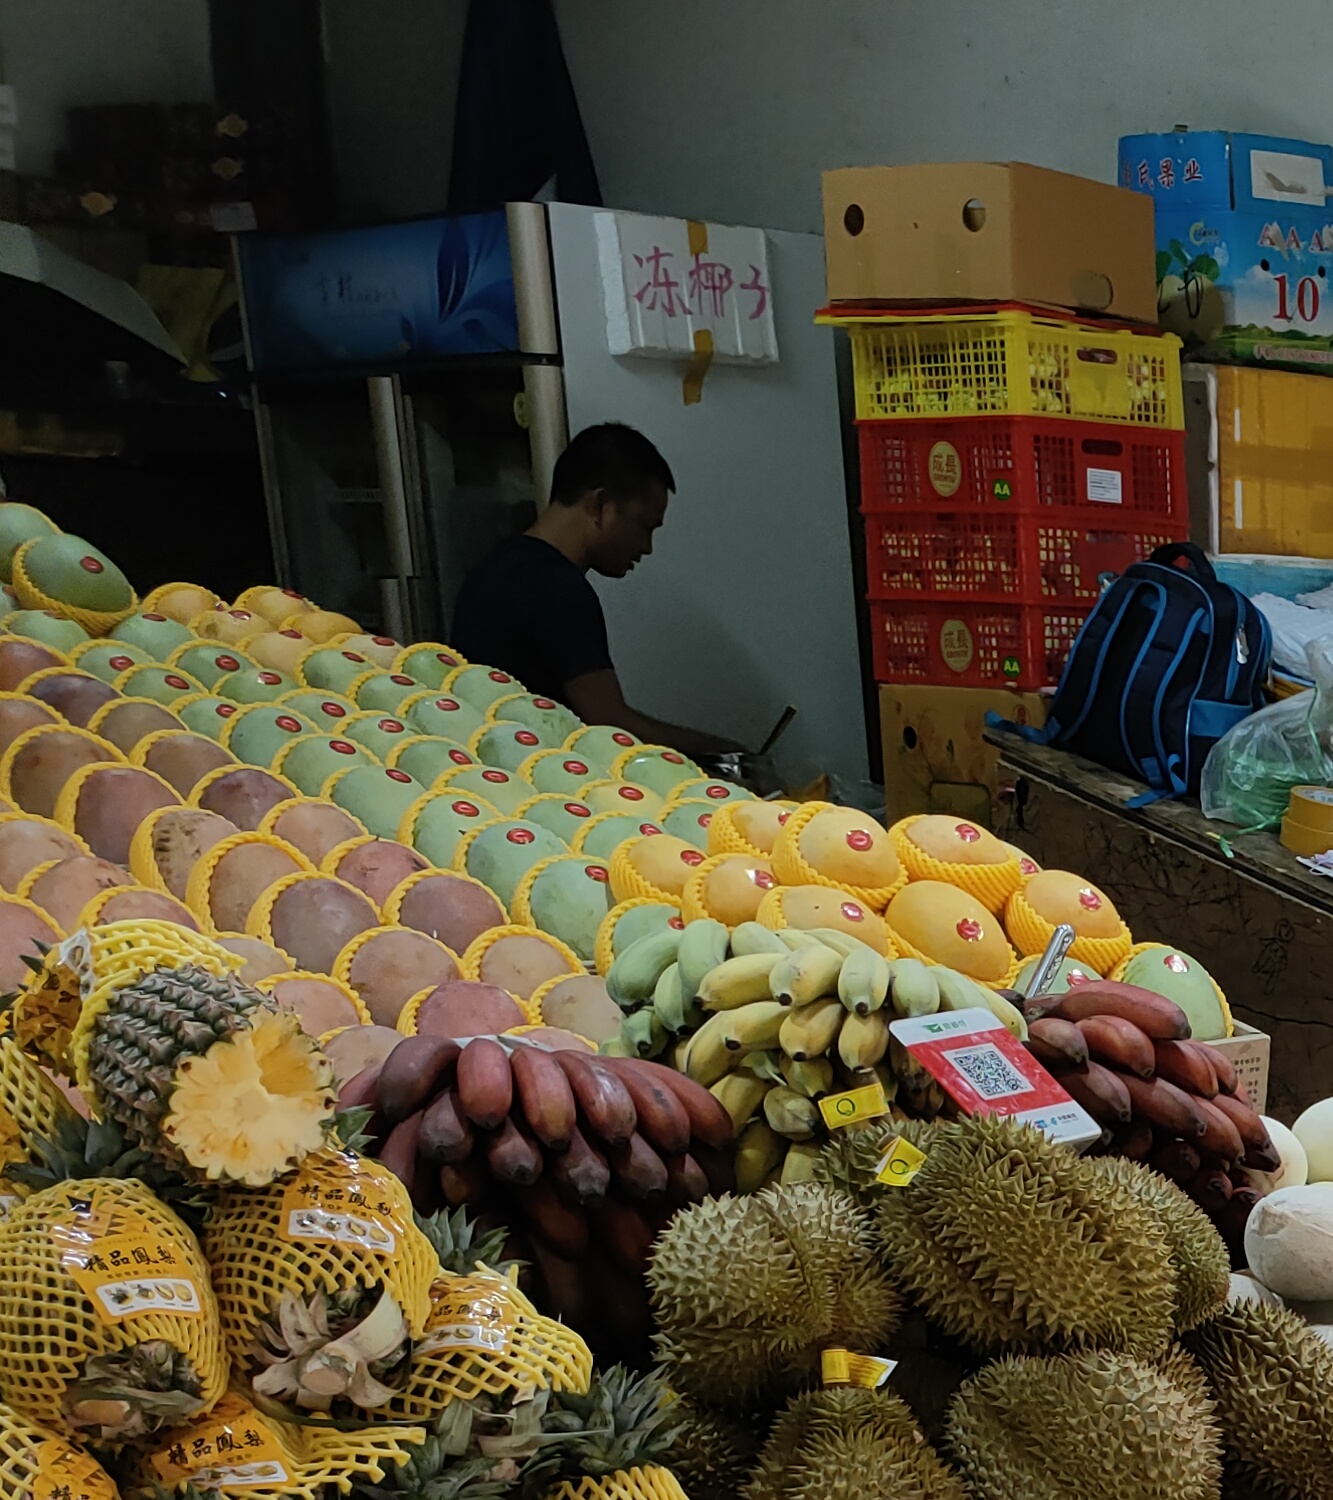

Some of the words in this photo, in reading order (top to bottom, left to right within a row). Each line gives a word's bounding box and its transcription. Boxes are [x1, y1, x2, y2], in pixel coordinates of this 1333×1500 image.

[633, 246, 770, 319] 冻椰子
[1273, 274, 1319, 322] 10
[993, 483, 1011, 497] AA
[1004, 660, 1020, 673] AA
[83, 1245, 176, 1273] 精品鳳梨
[169, 1430, 265, 1466] 精品鳳梨
